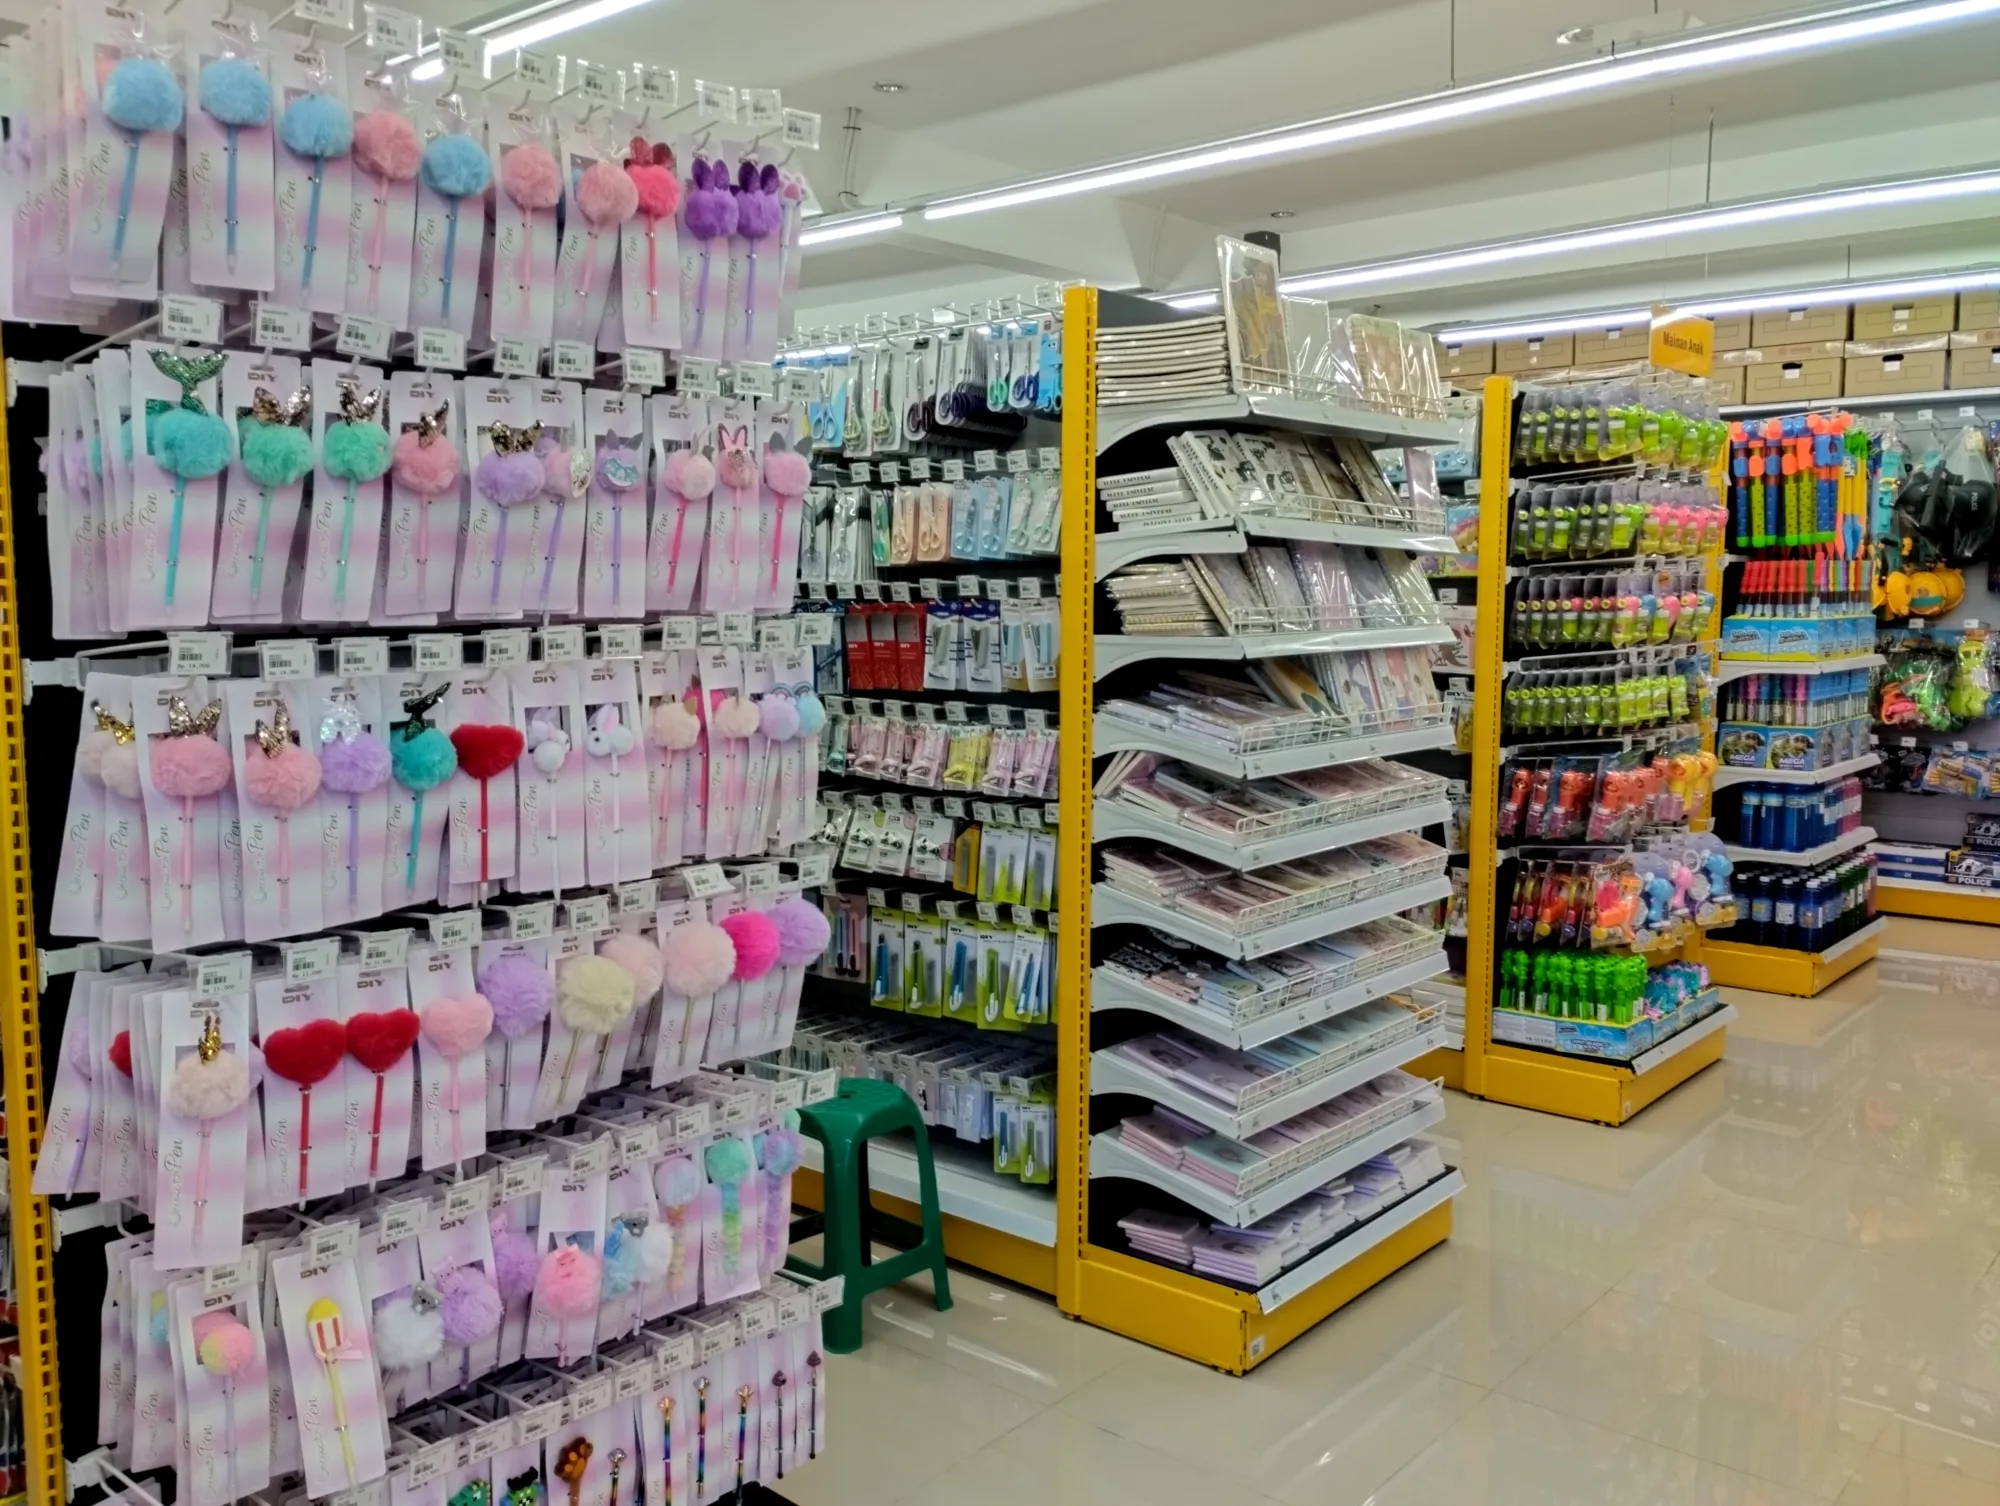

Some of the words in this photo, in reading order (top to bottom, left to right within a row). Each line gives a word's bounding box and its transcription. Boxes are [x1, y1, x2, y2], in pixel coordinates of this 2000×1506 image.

[1663, 331, 1688, 350] Mainan
[1689, 338, 1704, 355] Anak
[1958, 877, 1992, 887] POLICE
